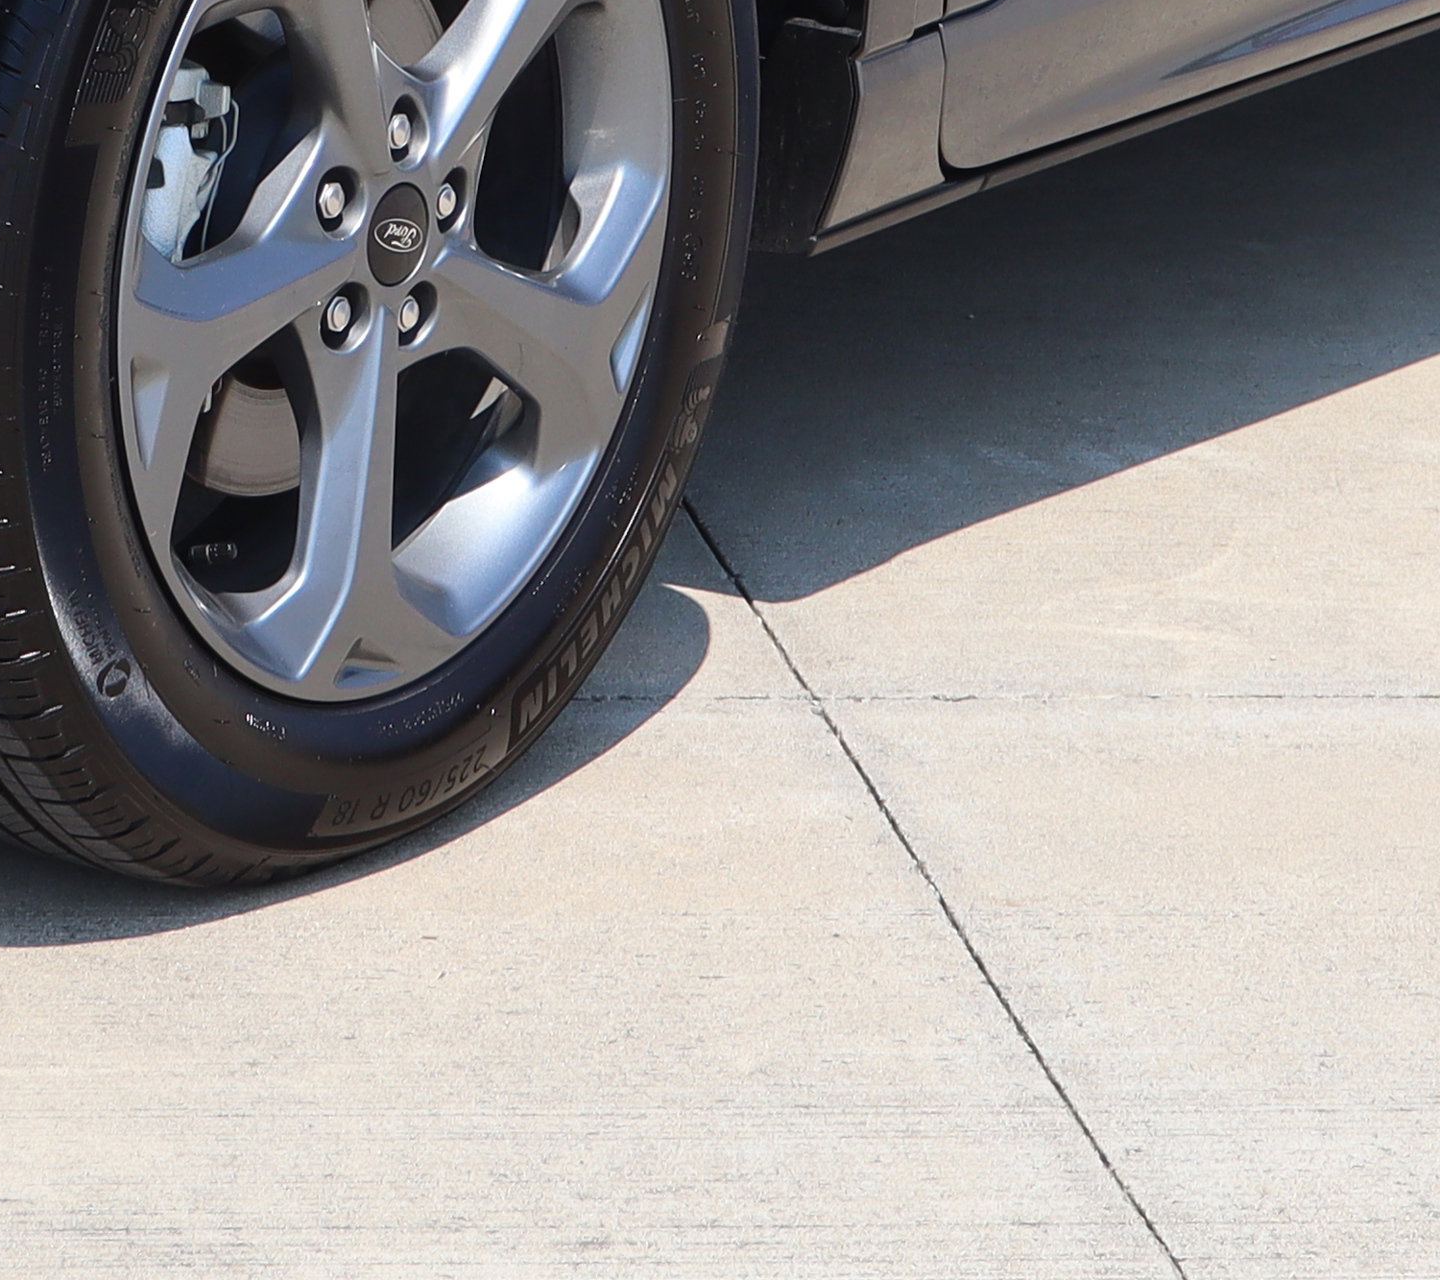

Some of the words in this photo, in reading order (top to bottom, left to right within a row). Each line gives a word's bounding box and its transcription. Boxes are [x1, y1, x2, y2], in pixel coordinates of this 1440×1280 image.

[383, 222, 418, 249] Ford
[519, 468, 678, 731] MICHELIN
[399, 743, 490, 810] 225/60
[331, 800, 359, 829] 18
[370, 790, 389, 820] R
